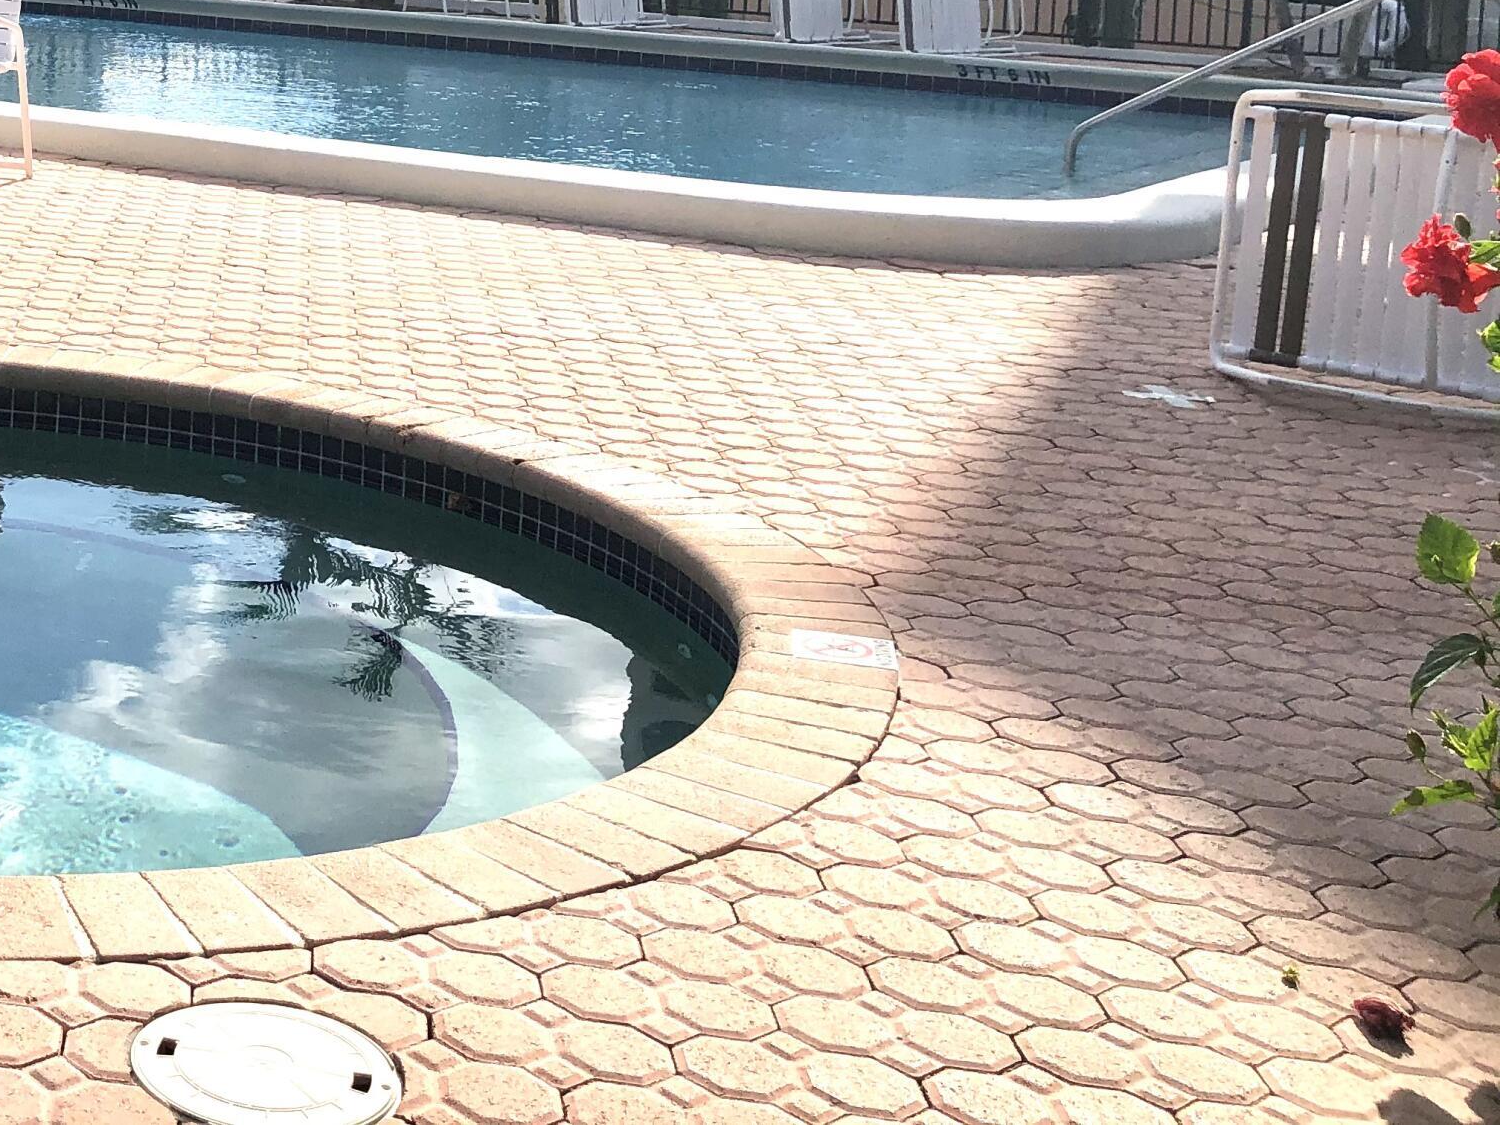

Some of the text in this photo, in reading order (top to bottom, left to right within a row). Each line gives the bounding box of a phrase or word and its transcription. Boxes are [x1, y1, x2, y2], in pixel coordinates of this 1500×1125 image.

[956, 64, 1051, 85] 3 FT 6 IN
